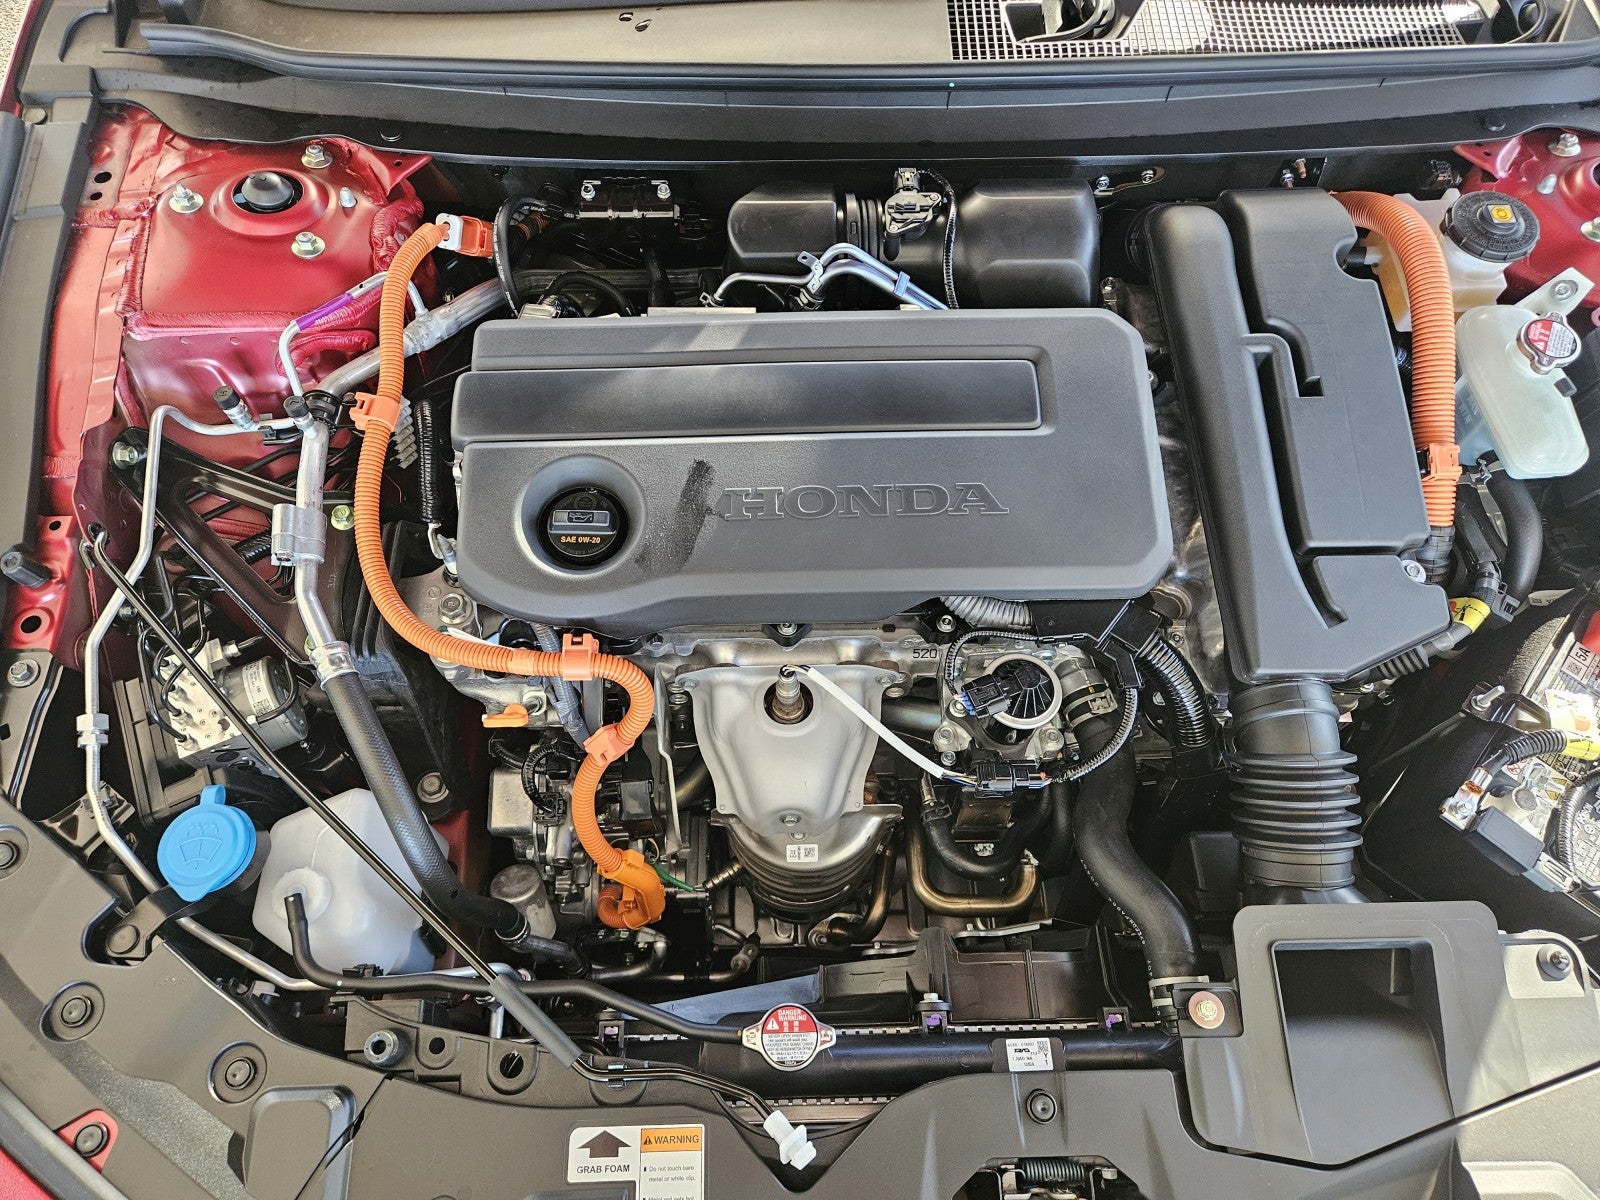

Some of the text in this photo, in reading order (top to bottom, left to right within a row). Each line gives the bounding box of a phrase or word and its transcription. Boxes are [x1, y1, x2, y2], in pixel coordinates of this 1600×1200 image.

[724, 483, 1009, 520] HONDA
[578, 536, 601, 544] 0W-20
[913, 648, 938, 659] 520
[1575, 646, 1591, 662] 5A
[654, 1135, 700, 1144] WARNING
[576, 1164, 630, 1174] GRAB FOAM
